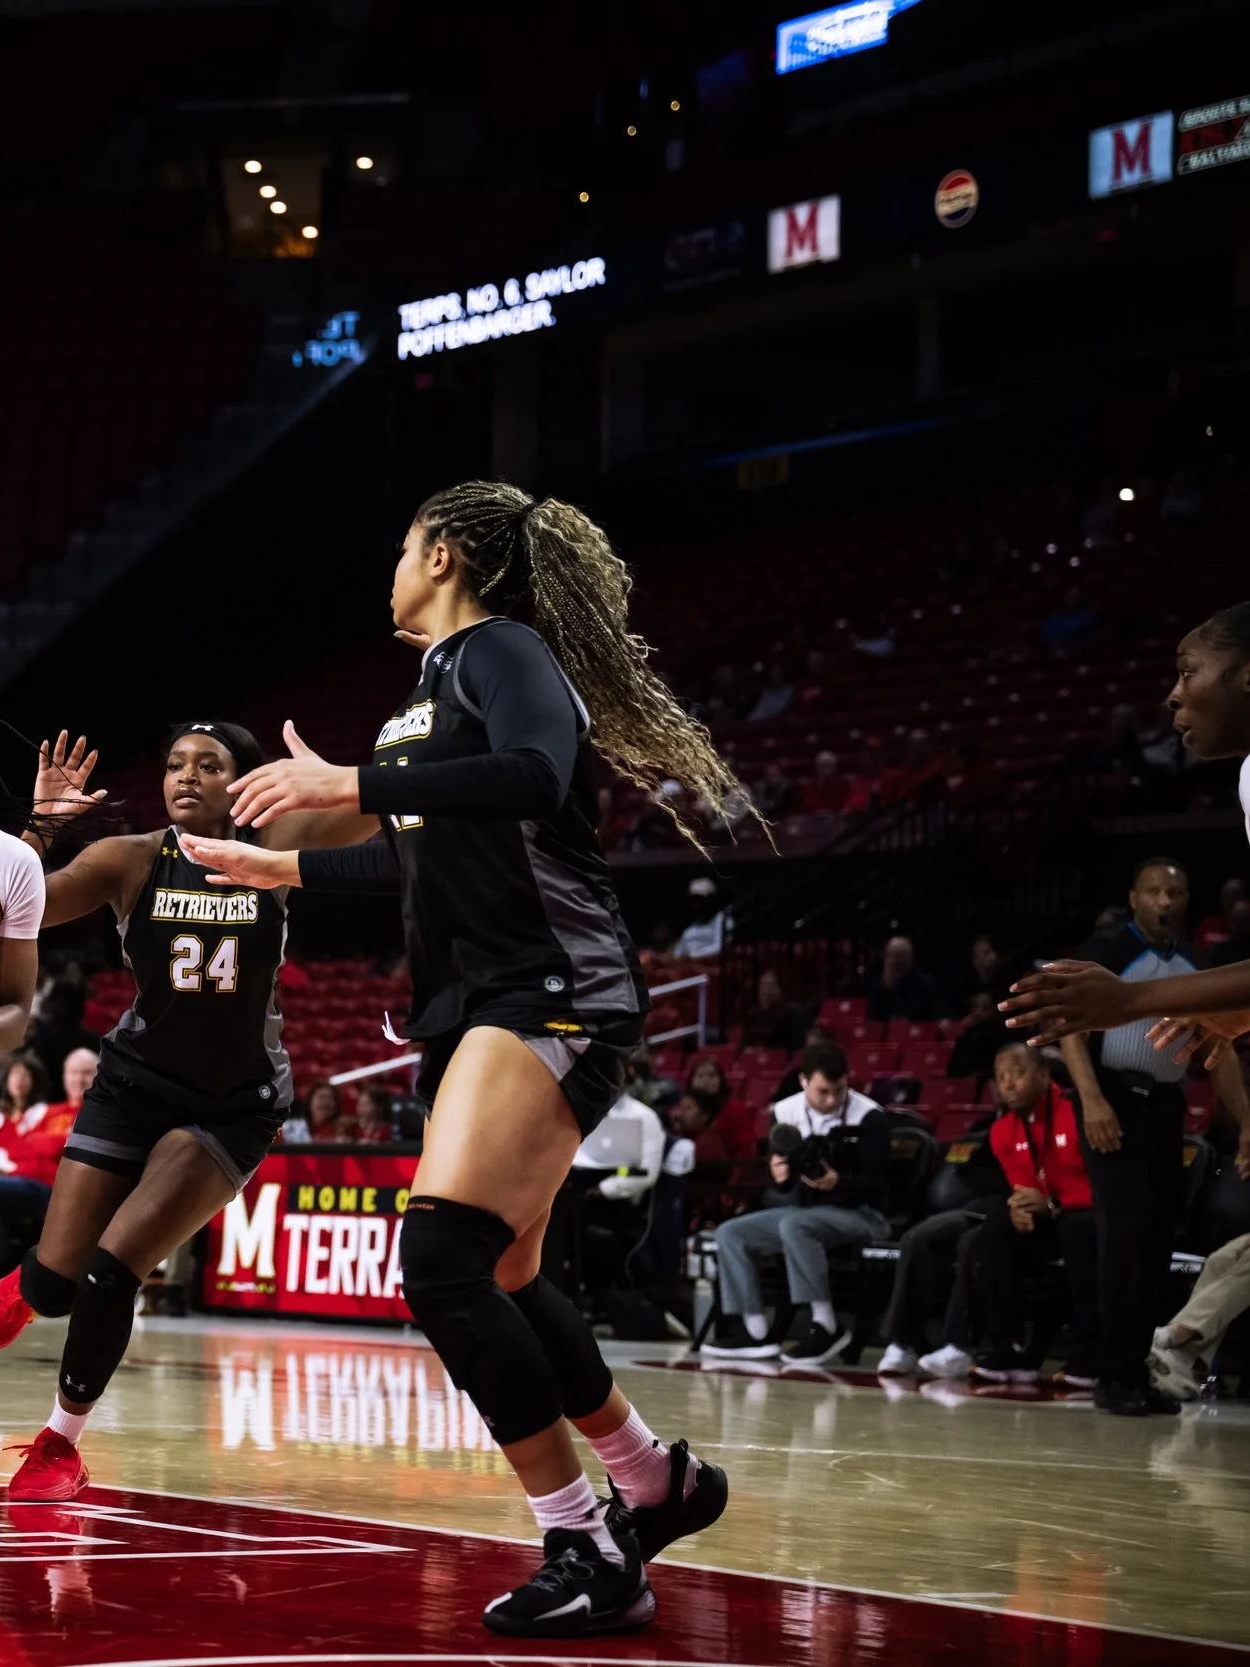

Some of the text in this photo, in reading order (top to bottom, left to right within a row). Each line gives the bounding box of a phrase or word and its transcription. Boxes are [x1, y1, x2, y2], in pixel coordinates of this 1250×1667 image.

[1109, 114, 1155, 190] M
[784, 200, 822, 268] M
[151, 888, 258, 924] RETRIEVERS
[170, 933, 239, 993] 24
[298, 1184, 377, 1212] HOME
[217, 1183, 281, 1279] M
